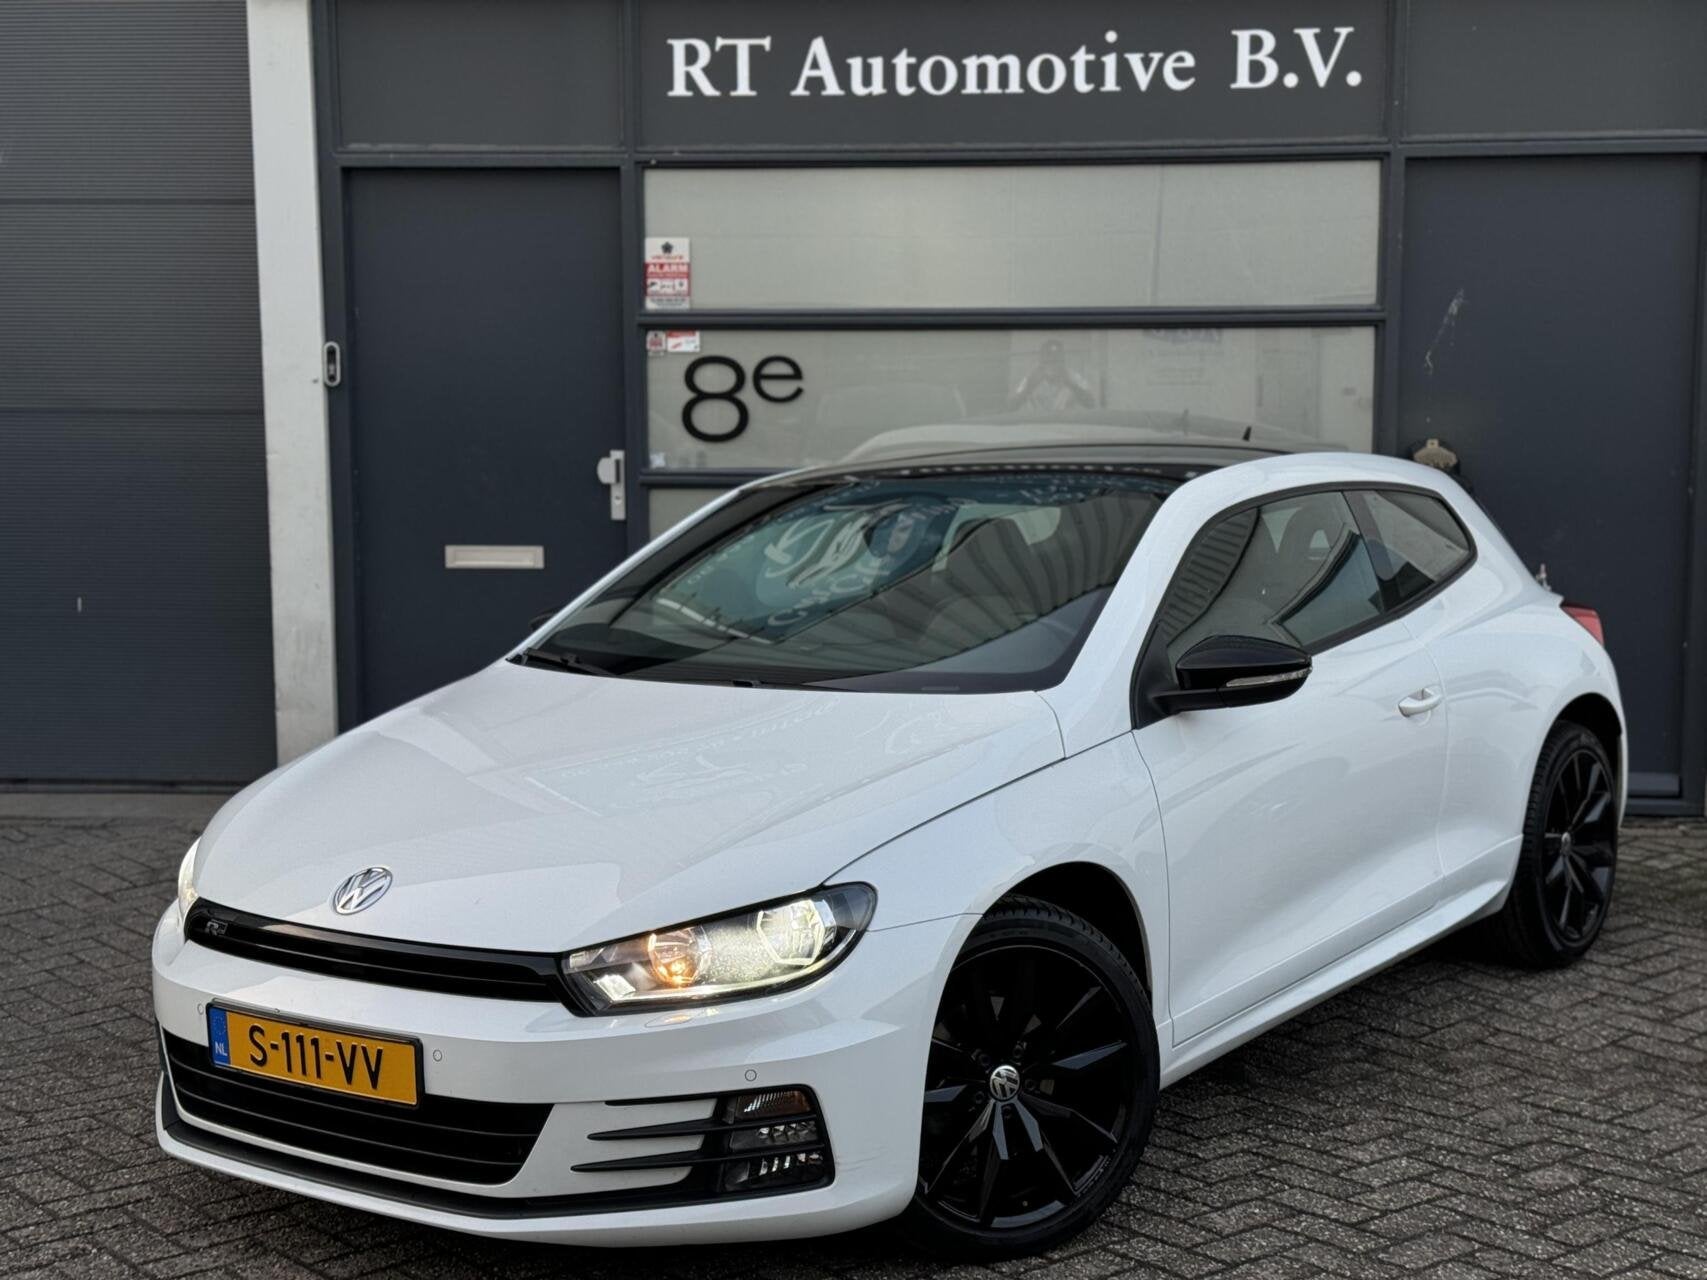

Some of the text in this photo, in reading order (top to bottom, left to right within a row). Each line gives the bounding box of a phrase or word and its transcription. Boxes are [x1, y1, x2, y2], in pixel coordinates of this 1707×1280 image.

[667, 27, 1362, 97] RT Automotive B.V.
[647, 262, 689, 273] ALARM
[681, 355, 804, 444] 8e
[214, 1041, 228, 1057] NL
[248, 1023, 384, 1090] S-111-VV
